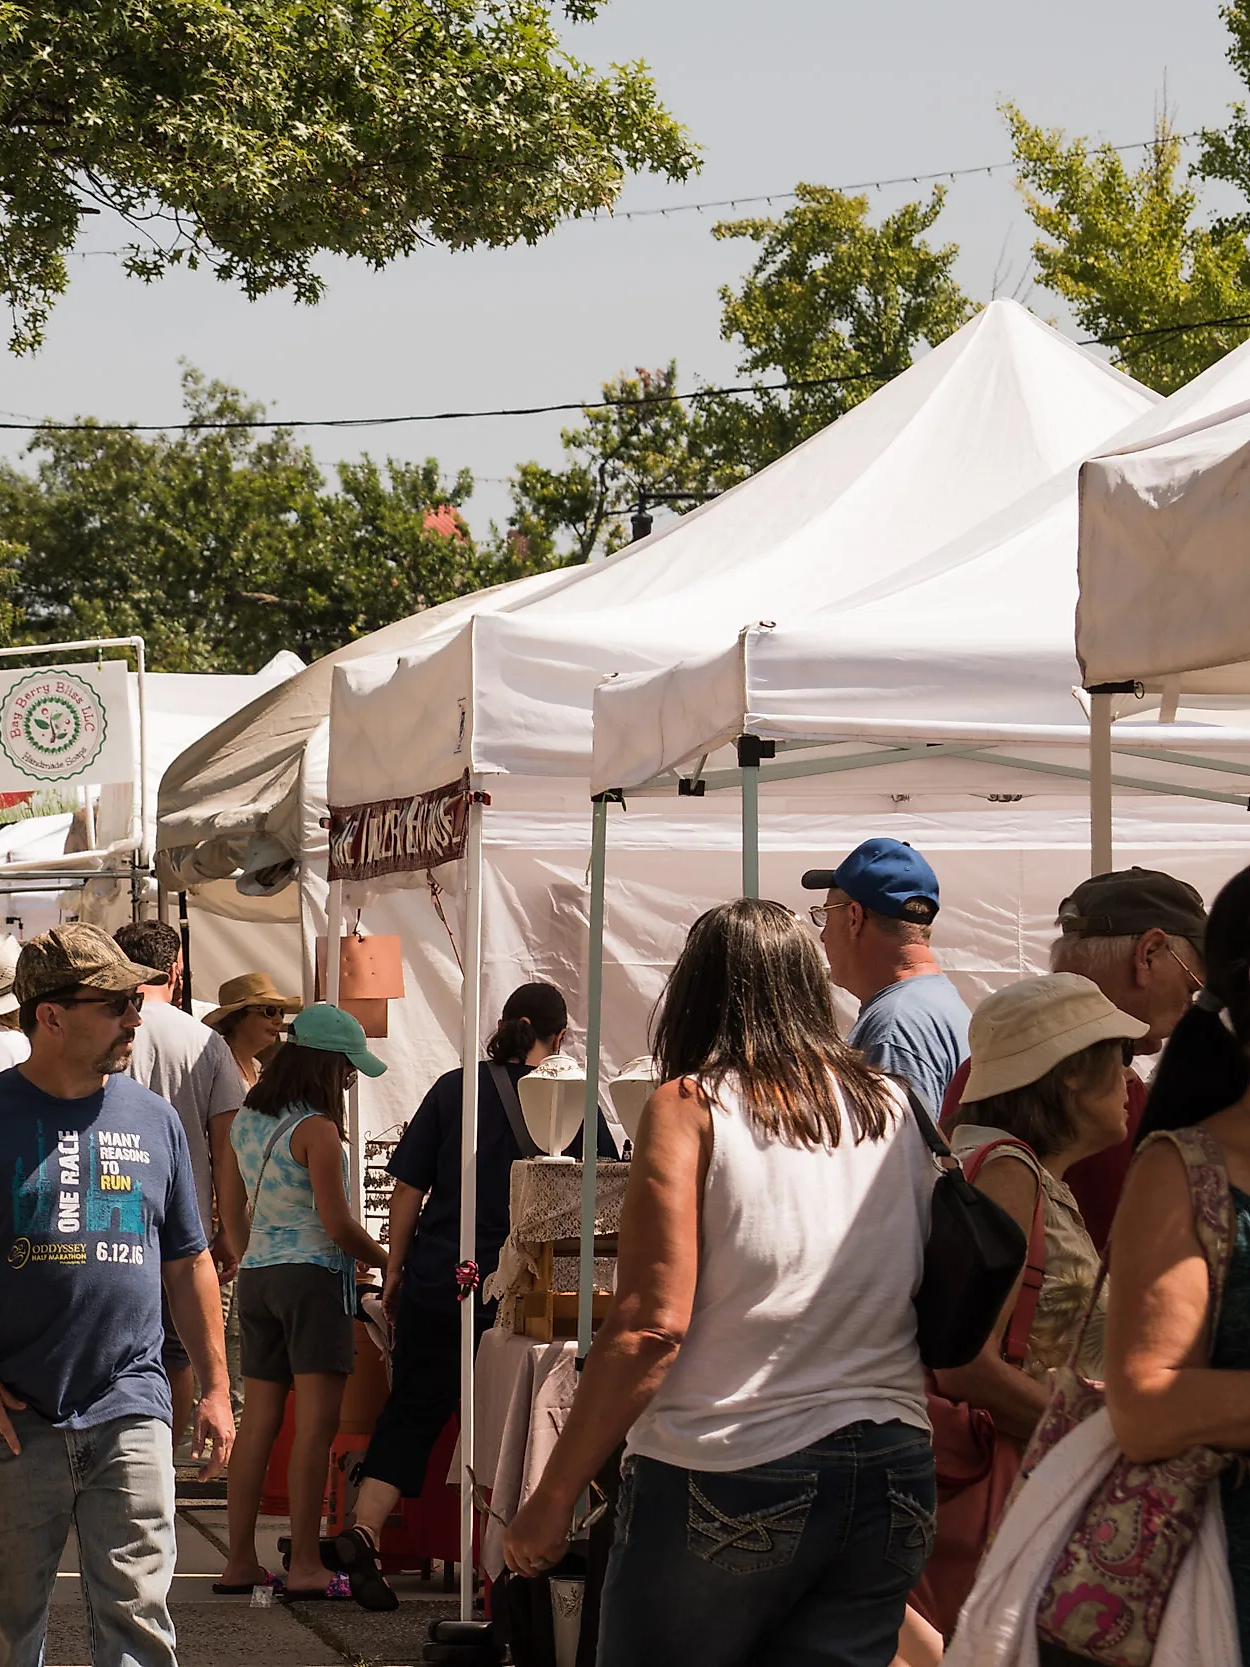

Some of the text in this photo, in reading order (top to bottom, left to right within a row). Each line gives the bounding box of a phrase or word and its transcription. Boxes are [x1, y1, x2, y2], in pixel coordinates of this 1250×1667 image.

[10, 681, 96, 739] Bay Berry Bliss LLC
[21, 746, 87, 770] Handmade Soaps
[98, 1131, 141, 1148] MANY
[58, 1130, 80, 1185] RACE
[100, 1147, 150, 1164] REASONS
[100, 1161, 120, 1175] TO
[100, 1175, 132, 1191] RUN
[58, 1191, 81, 1234] ONE
[31, 1243, 87, 1255] ODDYSSEY
[31, 1253, 87, 1262] HALF MARATHON
[95, 1241, 144, 1266] 6.12.16
